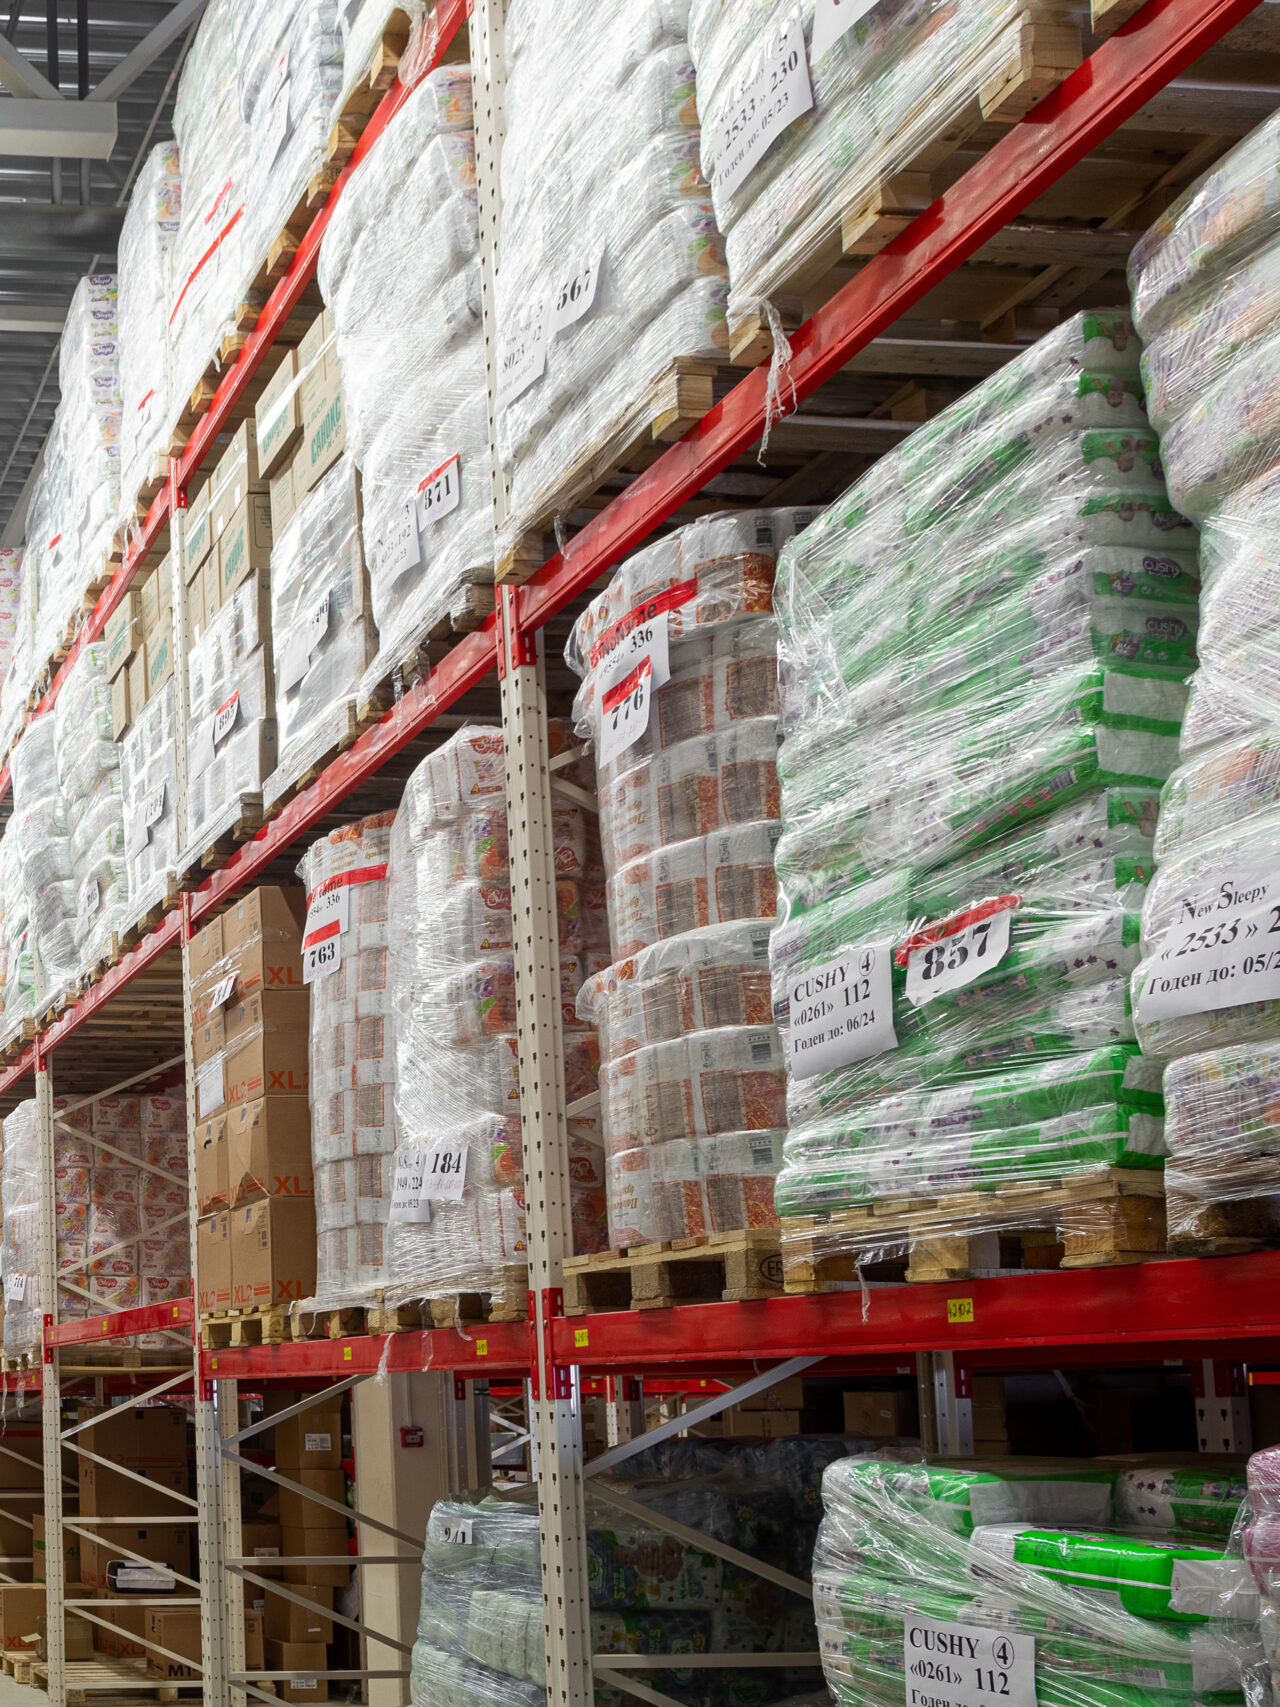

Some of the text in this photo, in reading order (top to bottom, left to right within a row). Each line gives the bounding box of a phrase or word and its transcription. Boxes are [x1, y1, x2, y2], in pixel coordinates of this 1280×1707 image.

[725, 98, 756, 151] 2533
[771, 50, 799, 94] 230
[761, 92, 789, 130] 05/23
[557, 270, 591, 311] 567
[424, 474, 451, 511] 871
[630, 626, 654, 654] 336
[611, 684, 645, 731] 776
[326, 893, 341, 910] 336
[1178, 880, 1270, 925] New Sleepy
[309, 942, 336, 969] 763
[922, 920, 992, 981] 857
[1175, 918, 1243, 958] 2533
[268, 966, 303, 985] XL
[793, 962, 850, 1003] CUSHY
[1147, 971, 1202, 996] Годен
[1205, 964, 1236, 985] до:
[793, 978, 871, 1028] «0261» 112
[793, 1009, 876, 1053] Годен до: 06/24
[269, 1070, 310, 1090] XL
[431, 1151, 462, 1174] 184
[276, 1279, 318, 1299] XL
[909, 1627, 981, 1659] CUSHY
[167, 1664, 193, 1678] M1
[910, 1659, 1011, 1696] «0261» 112
